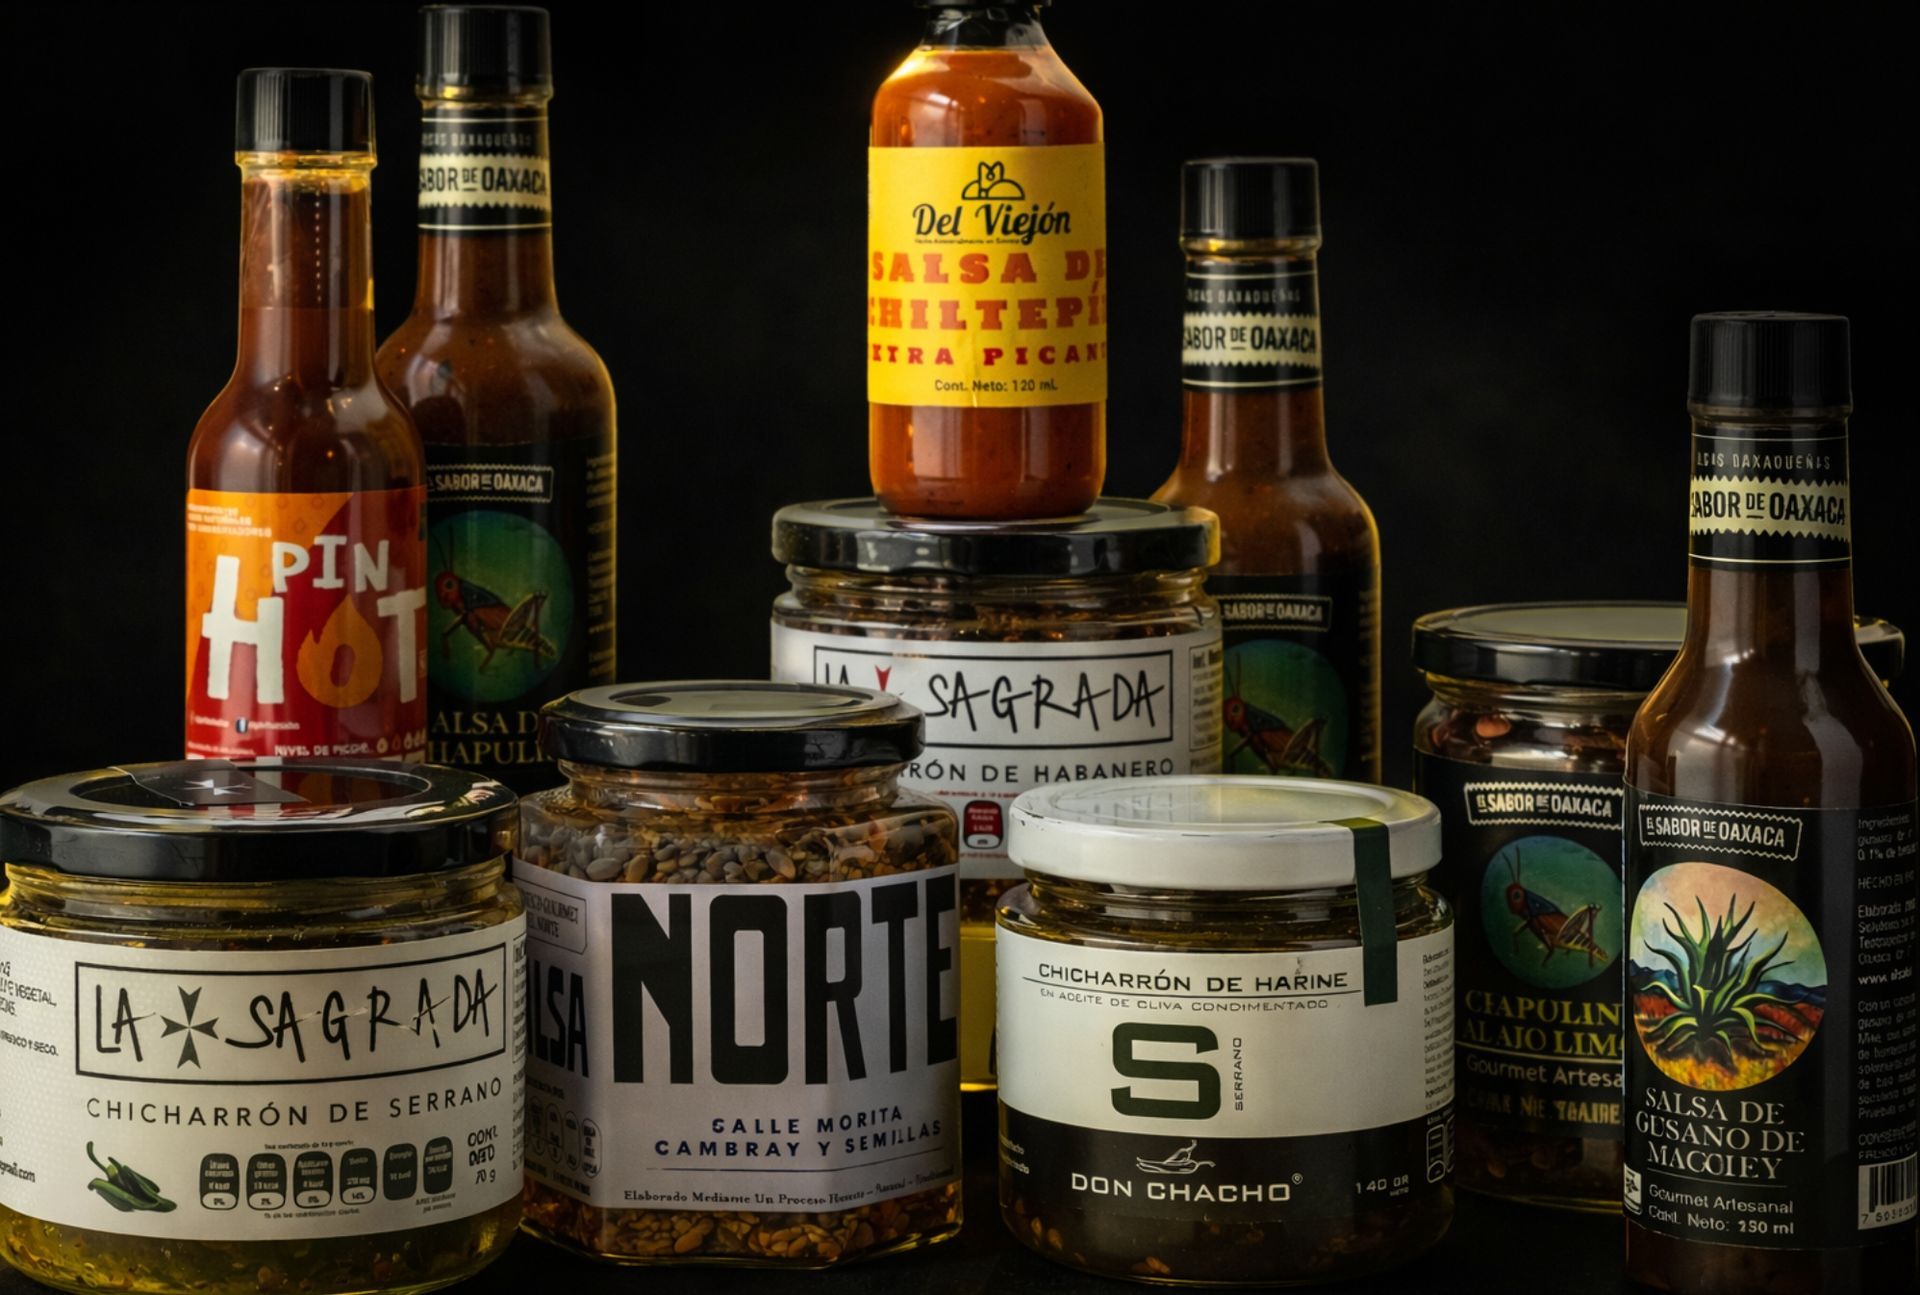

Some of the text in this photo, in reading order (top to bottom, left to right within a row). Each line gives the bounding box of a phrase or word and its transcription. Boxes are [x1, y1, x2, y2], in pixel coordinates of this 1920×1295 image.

[462, 167, 478, 183] DE
[481, 167, 547, 195] OAXACA
[913, 201, 1072, 246] Del Viejón
[872, 249, 1038, 285] SALSA
[1230, 326, 1247, 342] DE
[1250, 326, 1316, 354] OAXACA
[934, 379, 968, 392] Cont.
[972, 379, 1008, 392] Neto:
[1011, 379, 1036, 392] 120
[435, 473, 480, 493] SABOR
[493, 473, 545, 494] OAXACA
[1745, 492, 1766, 510] DE
[1769, 492, 1846, 526] OAXACA
[271, 534, 391, 595] PIN
[1276, 602, 1324, 623] OAXACA
[201, 553, 427, 709] HOT
[924, 669, 1166, 734] SAGRADA
[274, 743, 310, 757] NIVEL
[313, 744, 330, 757] DE
[981, 764, 1020, 783] DE
[1034, 755, 1175, 783] HABANERO
[1486, 792, 1536, 813] SABOR
[1550, 794, 1613, 818] OAXACA
[1655, 816, 1702, 838] SABOR
[1703, 820, 1717, 834] DE
[1718, 821, 1786, 848] OAXACA
[611, 873, 958, 1085] NORTE
[1038, 963, 1191, 992] CHICHARRÓN
[1206, 976, 1244, 992] DE
[1040, 988, 1055, 998] EN
[1059, 991, 1103, 1005] ACEITE
[1110, 998, 1130, 1008] DE
[94, 968, 498, 1063] LA SAGRADA
[1111, 1021, 1221, 1120] S
[1232, 1036, 1243, 1112] SERRANO
[1465, 1052, 1549, 1083] Gourmet
[86, 1096, 309, 1127] CHICHARRÓN
[329, 1100, 369, 1123] DE
[389, 1076, 502, 1118] SERRANO
[1645, 1087, 1729, 1122] SALSA
[1739, 1100, 1785, 1125] DE
[817, 1104, 903, 1134] MORITA
[655, 1120, 942, 1157] CAMBRAY Y SEMILLAS
[1760, 1129, 1805, 1153] DE
[624, 1190, 688, 1203] Elaborado
[754, 1192, 774, 1204] Un
[1071, 1172, 1133, 1198] DON
[1354, 1178, 1388, 1195] 140
[1648, 1183, 1795, 1214] Gourmet Artesanal
[1688, 1212, 1730, 1232] Neto:
[1738, 1220, 1768, 1234] 250
[1773, 1221, 1795, 1235] ml
